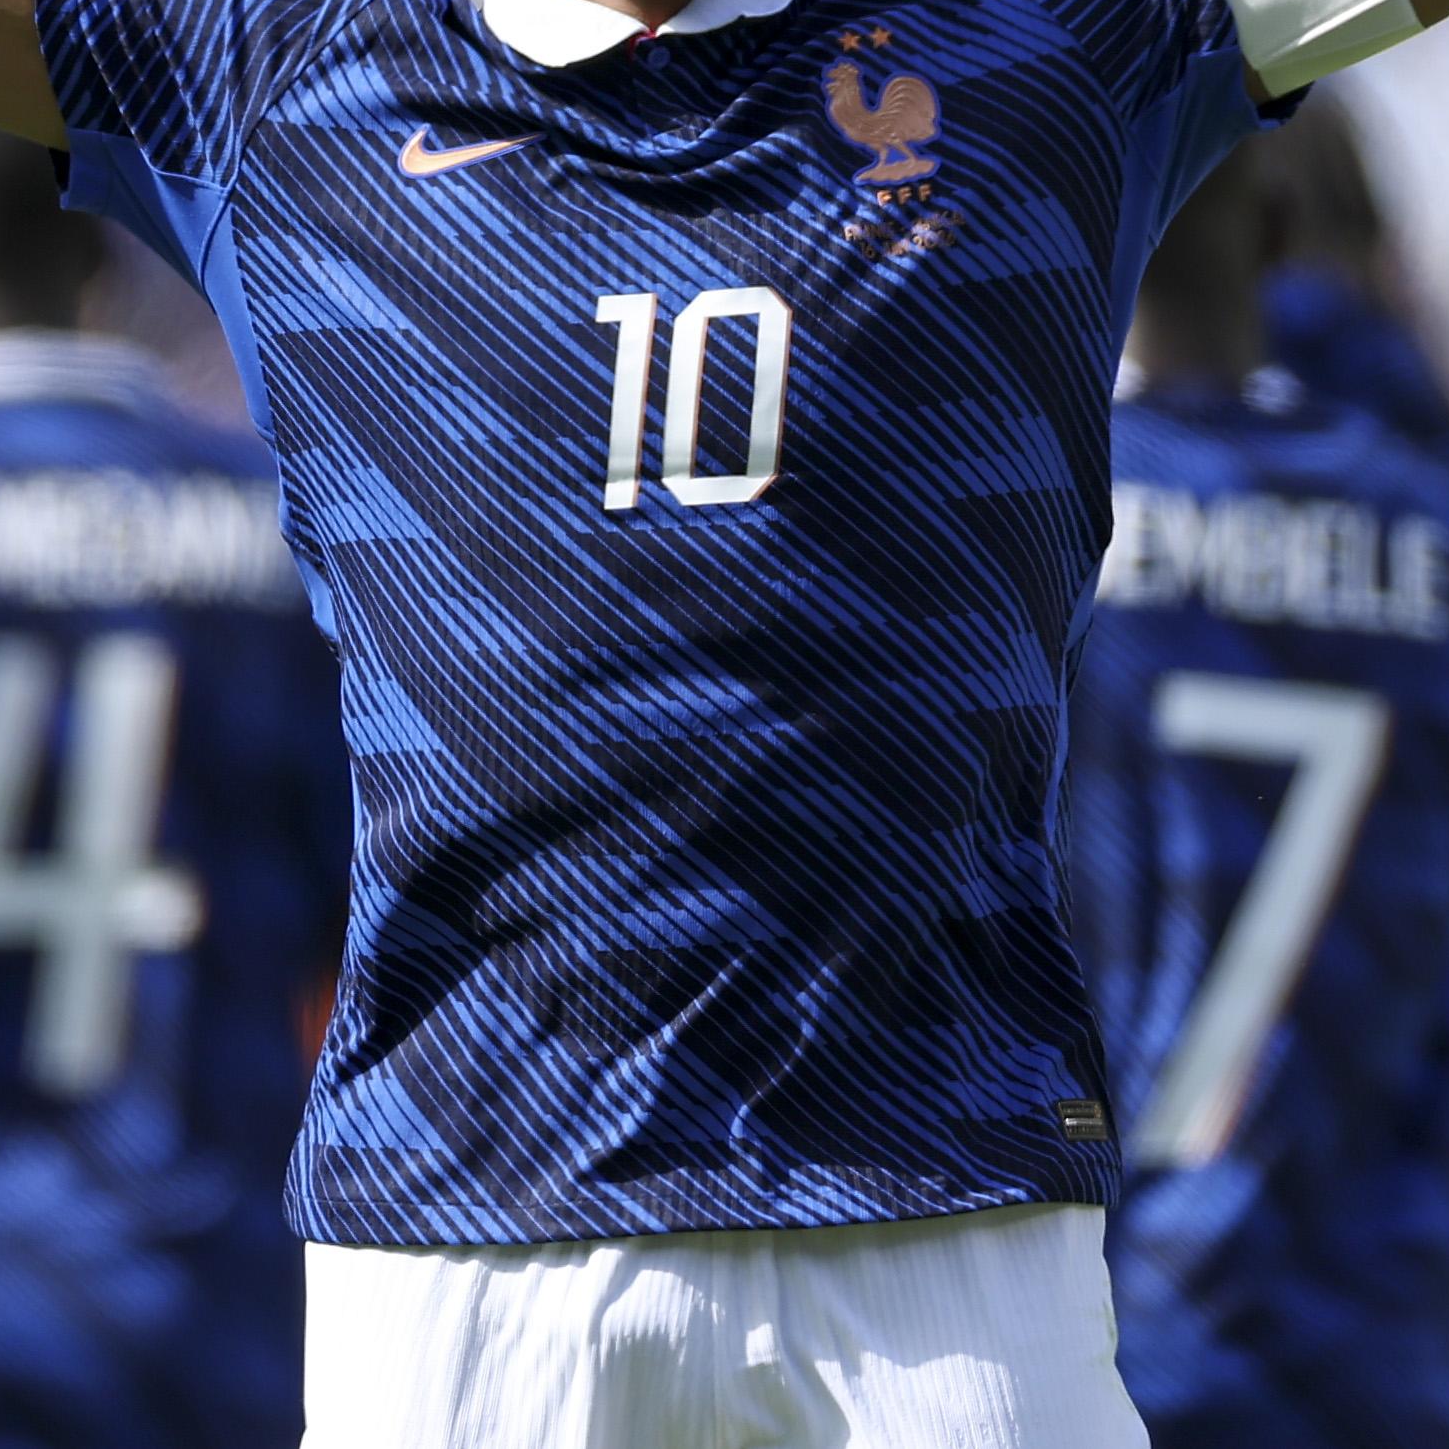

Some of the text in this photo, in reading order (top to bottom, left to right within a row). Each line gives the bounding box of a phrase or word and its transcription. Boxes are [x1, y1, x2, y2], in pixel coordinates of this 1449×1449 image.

[876, 183, 933, 206] FFF
[595, 286, 793, 510] 10
[1135, 669, 1388, 1168] 7
